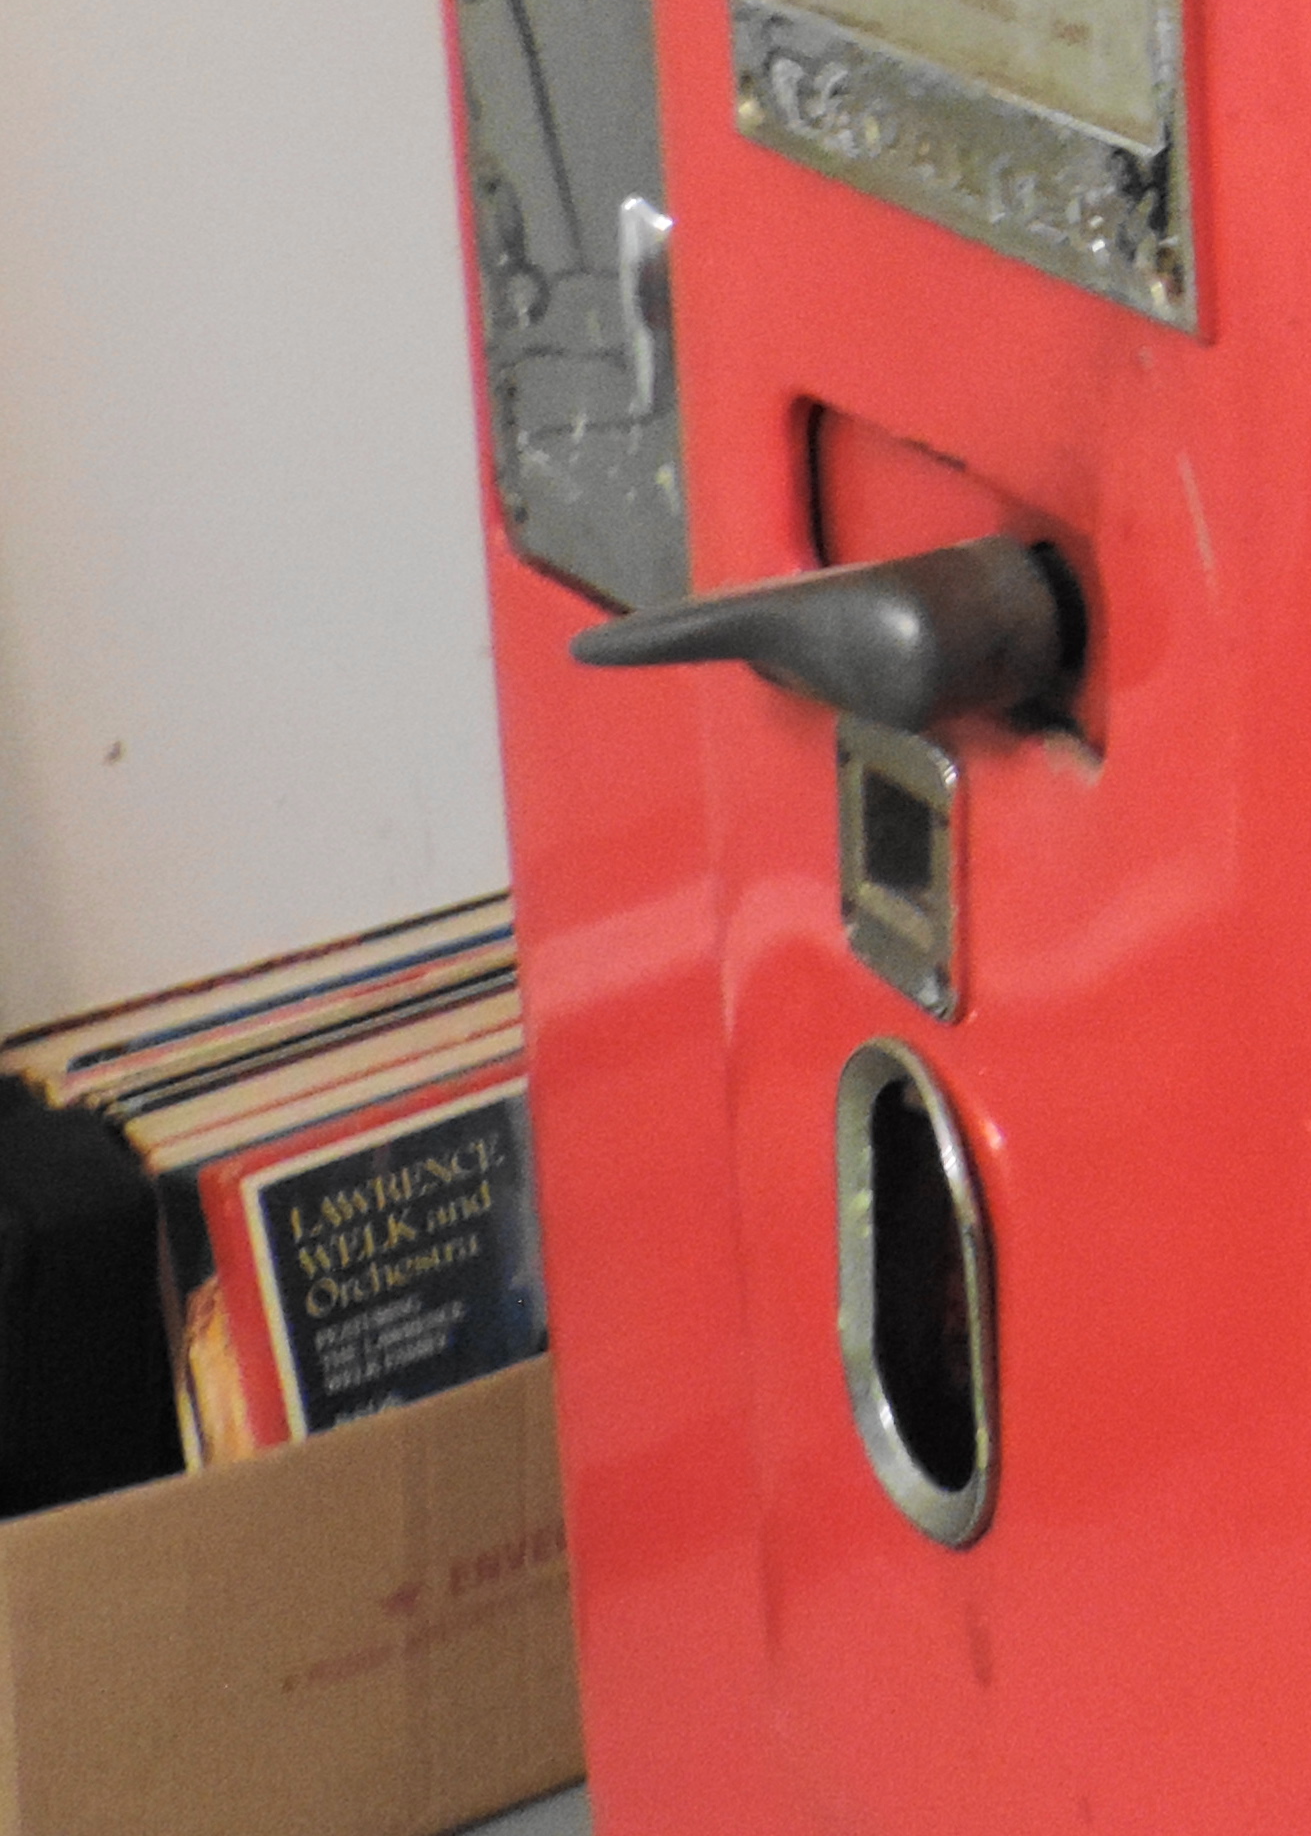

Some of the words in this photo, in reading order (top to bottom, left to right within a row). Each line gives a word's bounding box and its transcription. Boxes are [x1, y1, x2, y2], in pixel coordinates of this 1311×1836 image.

[290, 1134, 505, 1244] LAWRENCE
[300, 1209, 417, 1280] WELK
[427, 1178, 492, 1234] and
[306, 1234, 479, 1318] Orchestra
